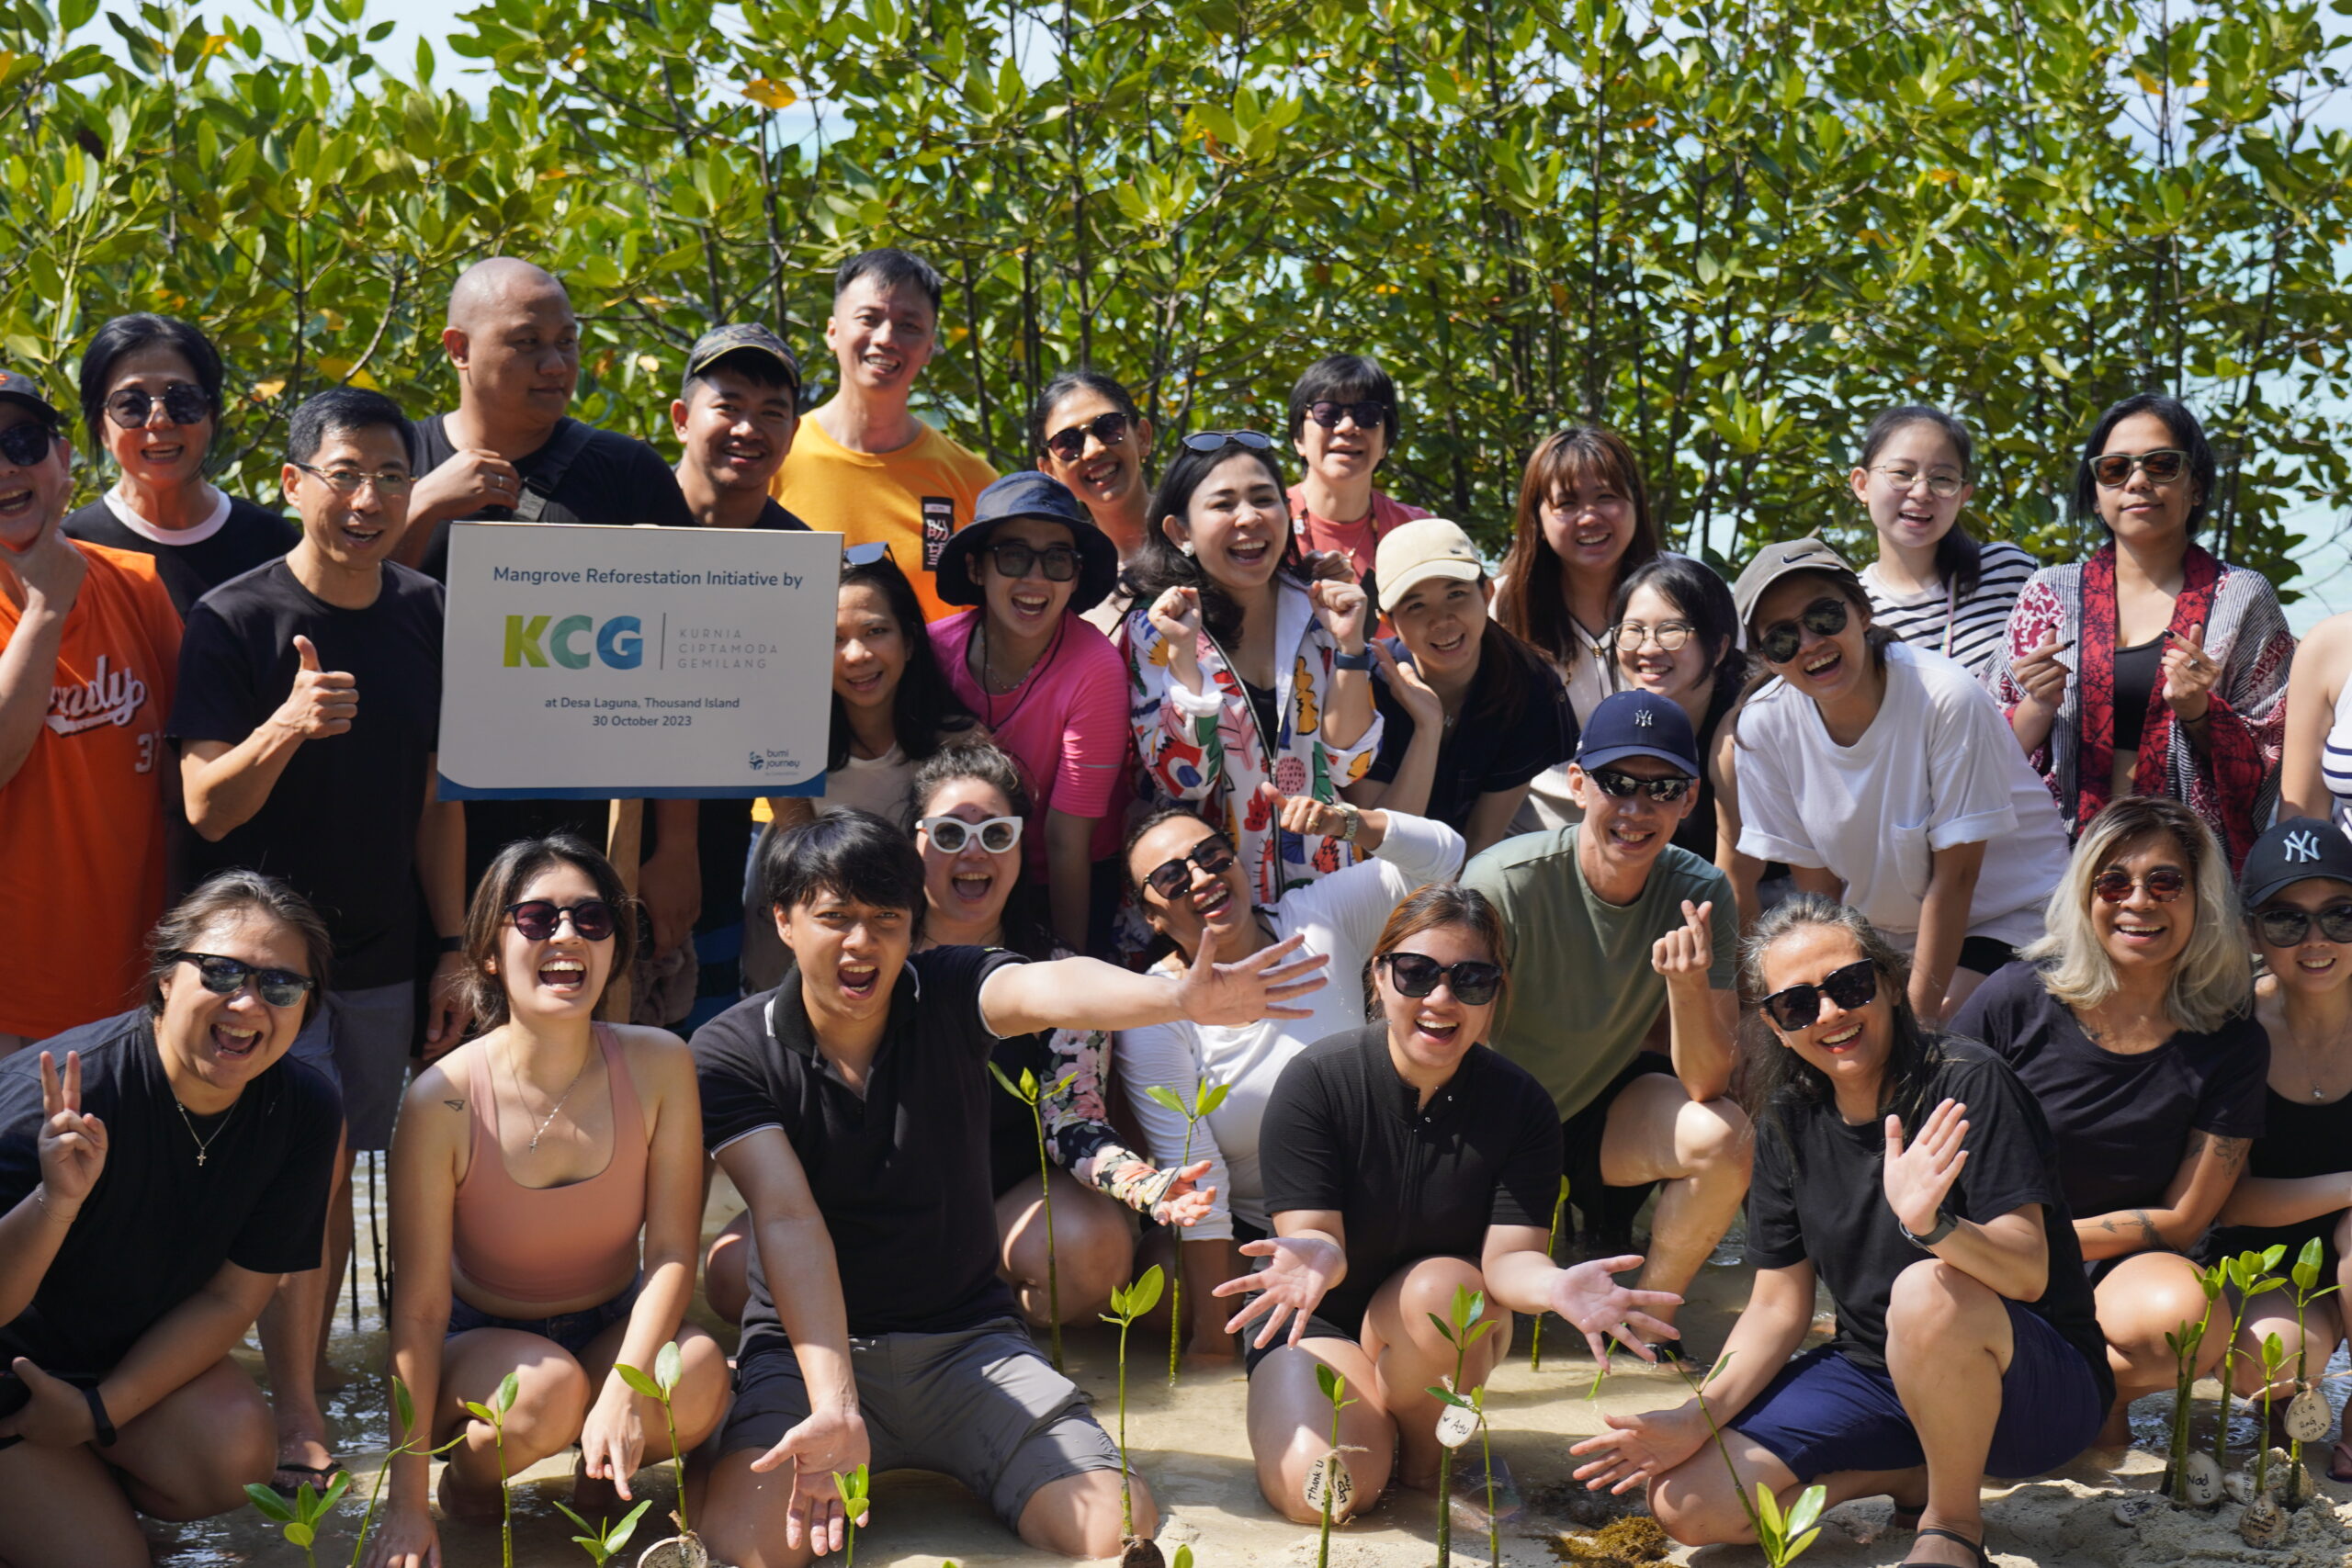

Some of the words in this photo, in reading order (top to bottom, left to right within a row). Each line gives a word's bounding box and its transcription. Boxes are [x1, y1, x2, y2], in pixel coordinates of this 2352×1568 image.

[493, 566, 582, 586] Mangrove
[586, 568, 702, 585] Reforestation
[707, 570, 778, 586] Initiative
[783, 572, 804, 590] by
[679, 628, 742, 639] KURNIA
[503, 614, 643, 671] KCG
[678, 643, 779, 654] CIPTAMODA
[677, 658, 767, 669] GEMILANG
[544, 698, 558, 709] at
[560, 697, 591, 709] Desa
[594, 697, 641, 711] Laguna,
[644, 697, 702, 709] Thousand
[705, 697, 741, 709] Island
[592, 715, 608, 727] 30
[611, 715, 659, 727] October
[662, 715, 693, 727] 2023
[766, 749, 789, 758] bumi
[765, 760, 800, 770] journey
[2282, 829, 2322, 863] NY
[1307, 1471, 1322, 1500] Thank
